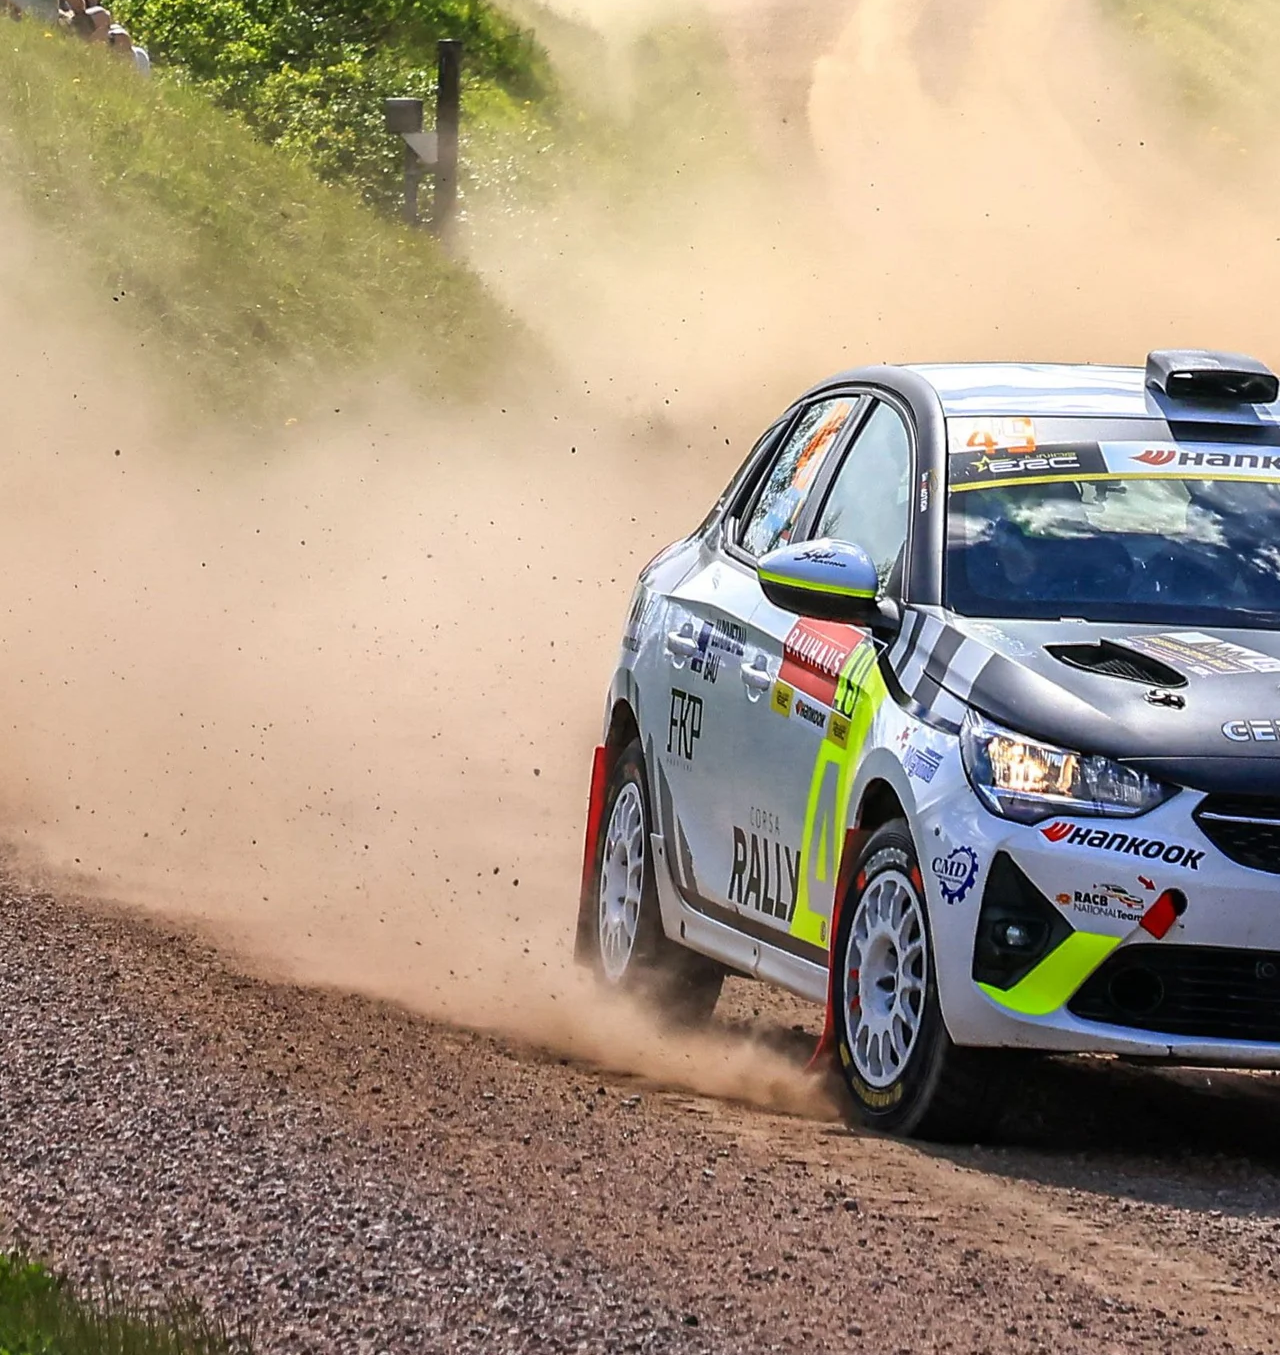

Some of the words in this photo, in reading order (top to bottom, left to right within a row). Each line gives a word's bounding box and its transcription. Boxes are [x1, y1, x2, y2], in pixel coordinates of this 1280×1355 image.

[989, 456, 1080, 473] ERC
[785, 628, 847, 677] BAUHAUS
[667, 686, 704, 760] FKP
[728, 826, 802, 923] RALLY
[931, 856, 968, 877] CMD
[1074, 891, 1109, 907] RACB
